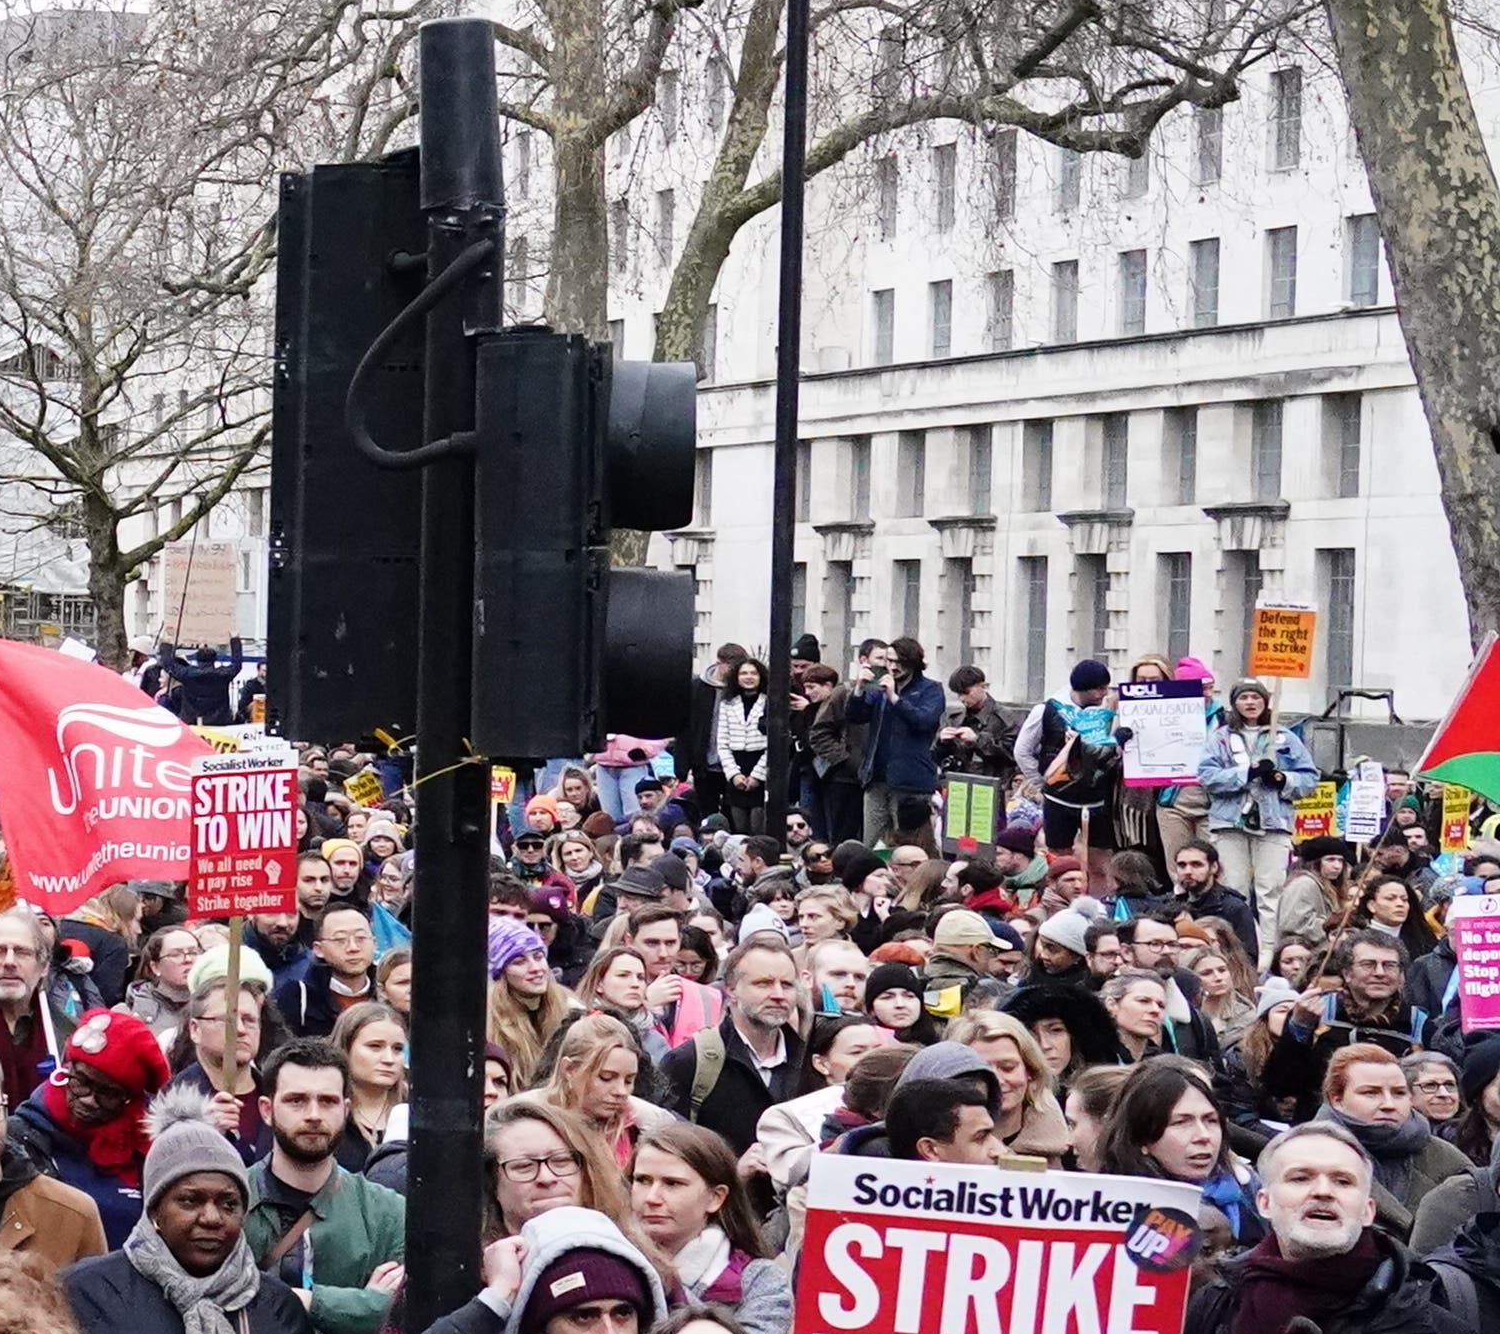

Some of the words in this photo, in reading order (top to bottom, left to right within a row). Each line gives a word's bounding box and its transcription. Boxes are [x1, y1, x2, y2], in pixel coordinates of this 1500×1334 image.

[1260, 612, 1300, 625] Defend
[1272, 641, 1307, 654] strike
[1281, 628, 1308, 643] right
[194, 773, 291, 815] STRIKE
[195, 816, 228, 853] TO
[236, 811, 291, 851] WIN
[854, 1173, 1013, 1218] Socialist
[1019, 1188, 1152, 1224] Worker
